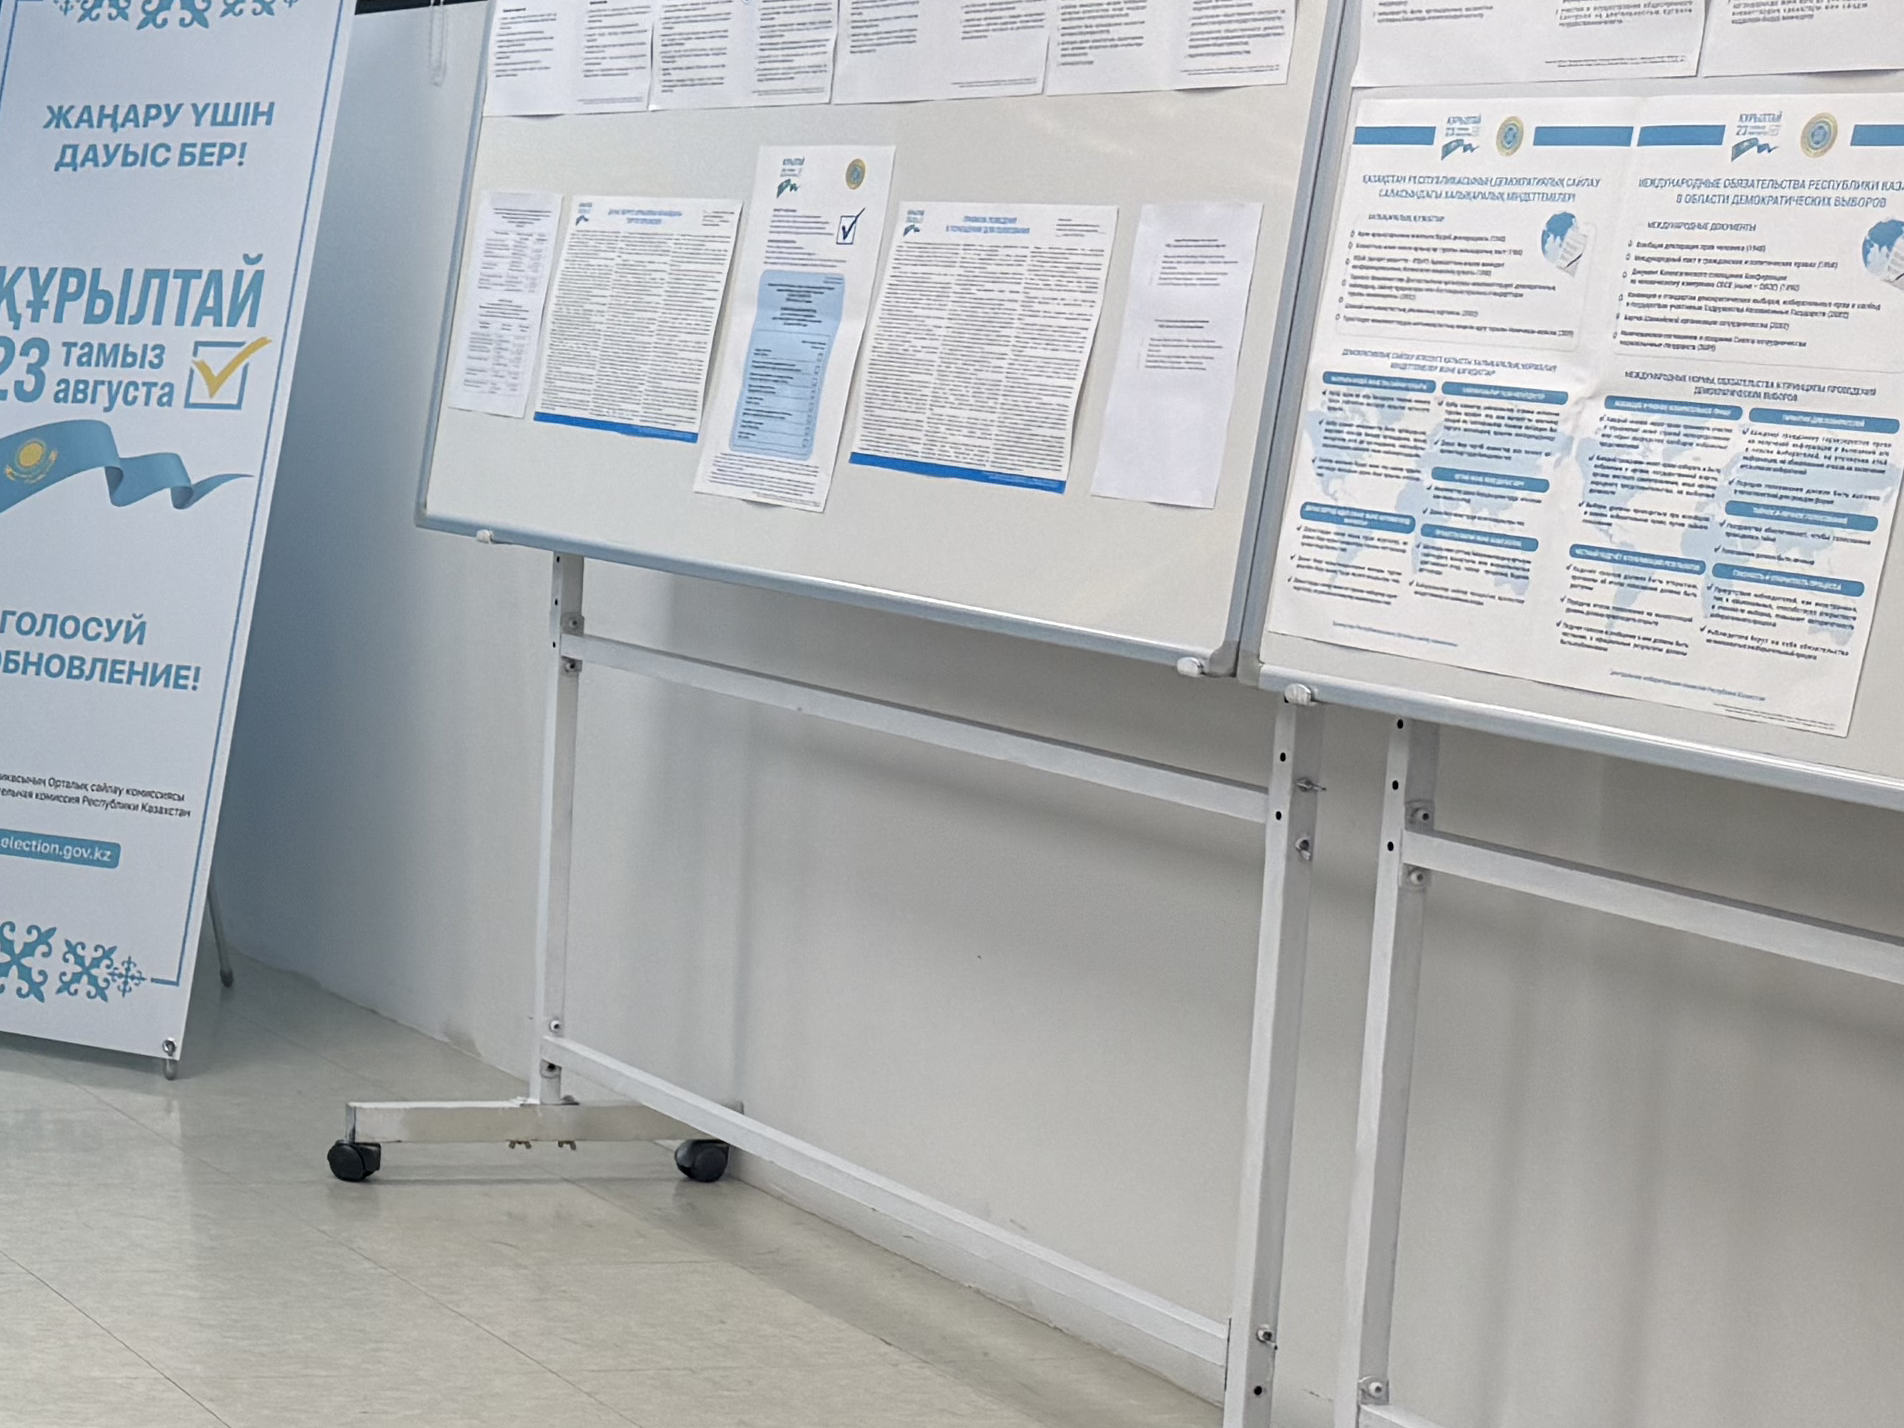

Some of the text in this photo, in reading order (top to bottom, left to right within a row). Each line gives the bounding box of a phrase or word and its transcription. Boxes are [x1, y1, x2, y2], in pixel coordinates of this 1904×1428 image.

[43, 101, 275, 134] ЖАҢАРУ ҮШІН
[54, 142, 247, 173] ДАУЫС БЕР!
[61, 341, 167, 370] тамыз
[53, 377, 175, 413] августа
[35, 791, 80, 805] комиссия
[81, 795, 139, 811] Республики
